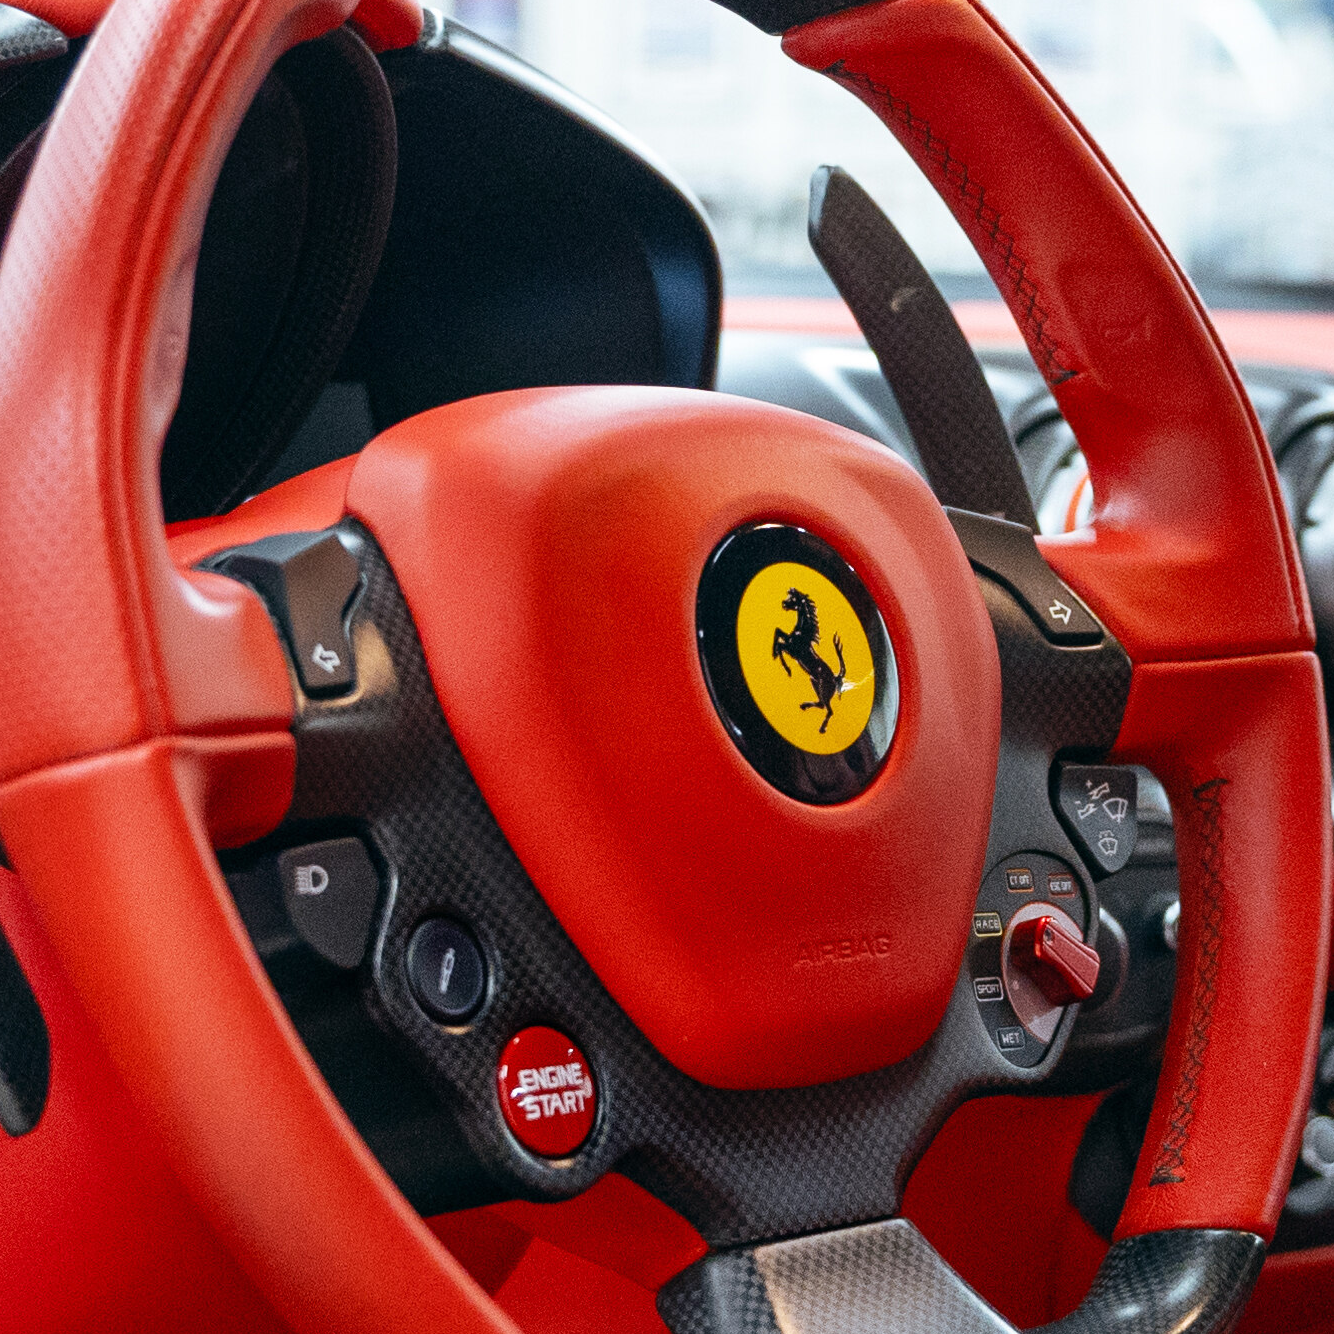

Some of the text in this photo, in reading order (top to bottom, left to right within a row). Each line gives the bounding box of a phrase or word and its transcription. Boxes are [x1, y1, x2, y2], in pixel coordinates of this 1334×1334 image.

[975, 919, 1000, 929] RACE
[977, 983, 999, 994] SPORT
[1001, 1032, 1020, 1044] WET
[517, 1062, 584, 1091] ENGINE
[525, 1089, 586, 1121] START
